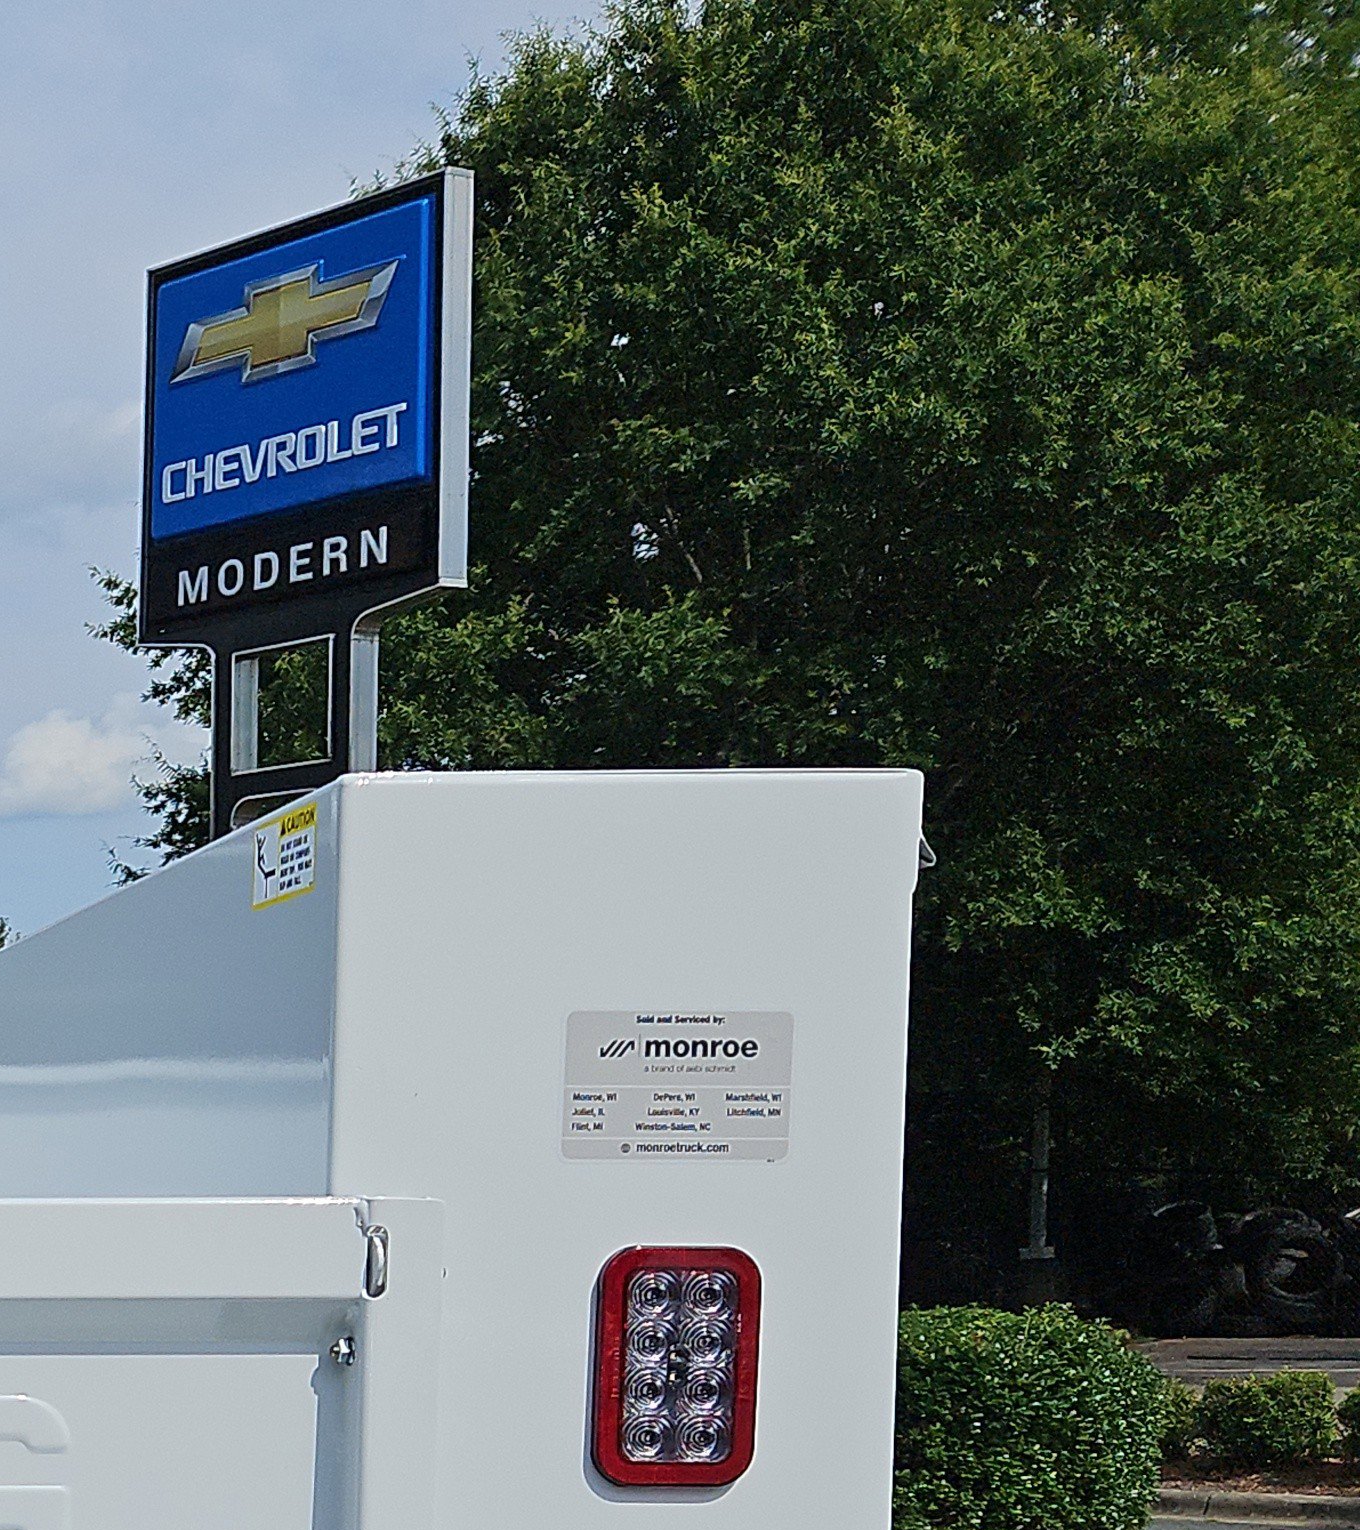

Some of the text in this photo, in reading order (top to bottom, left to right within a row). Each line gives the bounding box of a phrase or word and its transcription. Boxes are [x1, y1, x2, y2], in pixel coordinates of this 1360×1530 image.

[161, 401, 408, 504] CHEVROLET
[177, 524, 389, 607] MODERN
[656, 1015, 673, 1024] and
[674, 1015, 711, 1024] Serviced
[713, 1015, 726, 1026] by:
[644, 1039, 759, 1058] monroe
[651, 1064, 675, 1073] brand
[572, 1092, 617, 1102] Monroe, WI
[684, 1092, 695, 1101] WI
[725, 1093, 770, 1103] Marshfield,
[647, 1107, 700, 1117] Louisville, KY
[726, 1108, 765, 1118] Litchfield,
[571, 1122, 603, 1132] Flint, MI
[635, 1122, 711, 1132] Winston-Salem, NC
[636, 1142, 729, 1153] monroetruck.com
